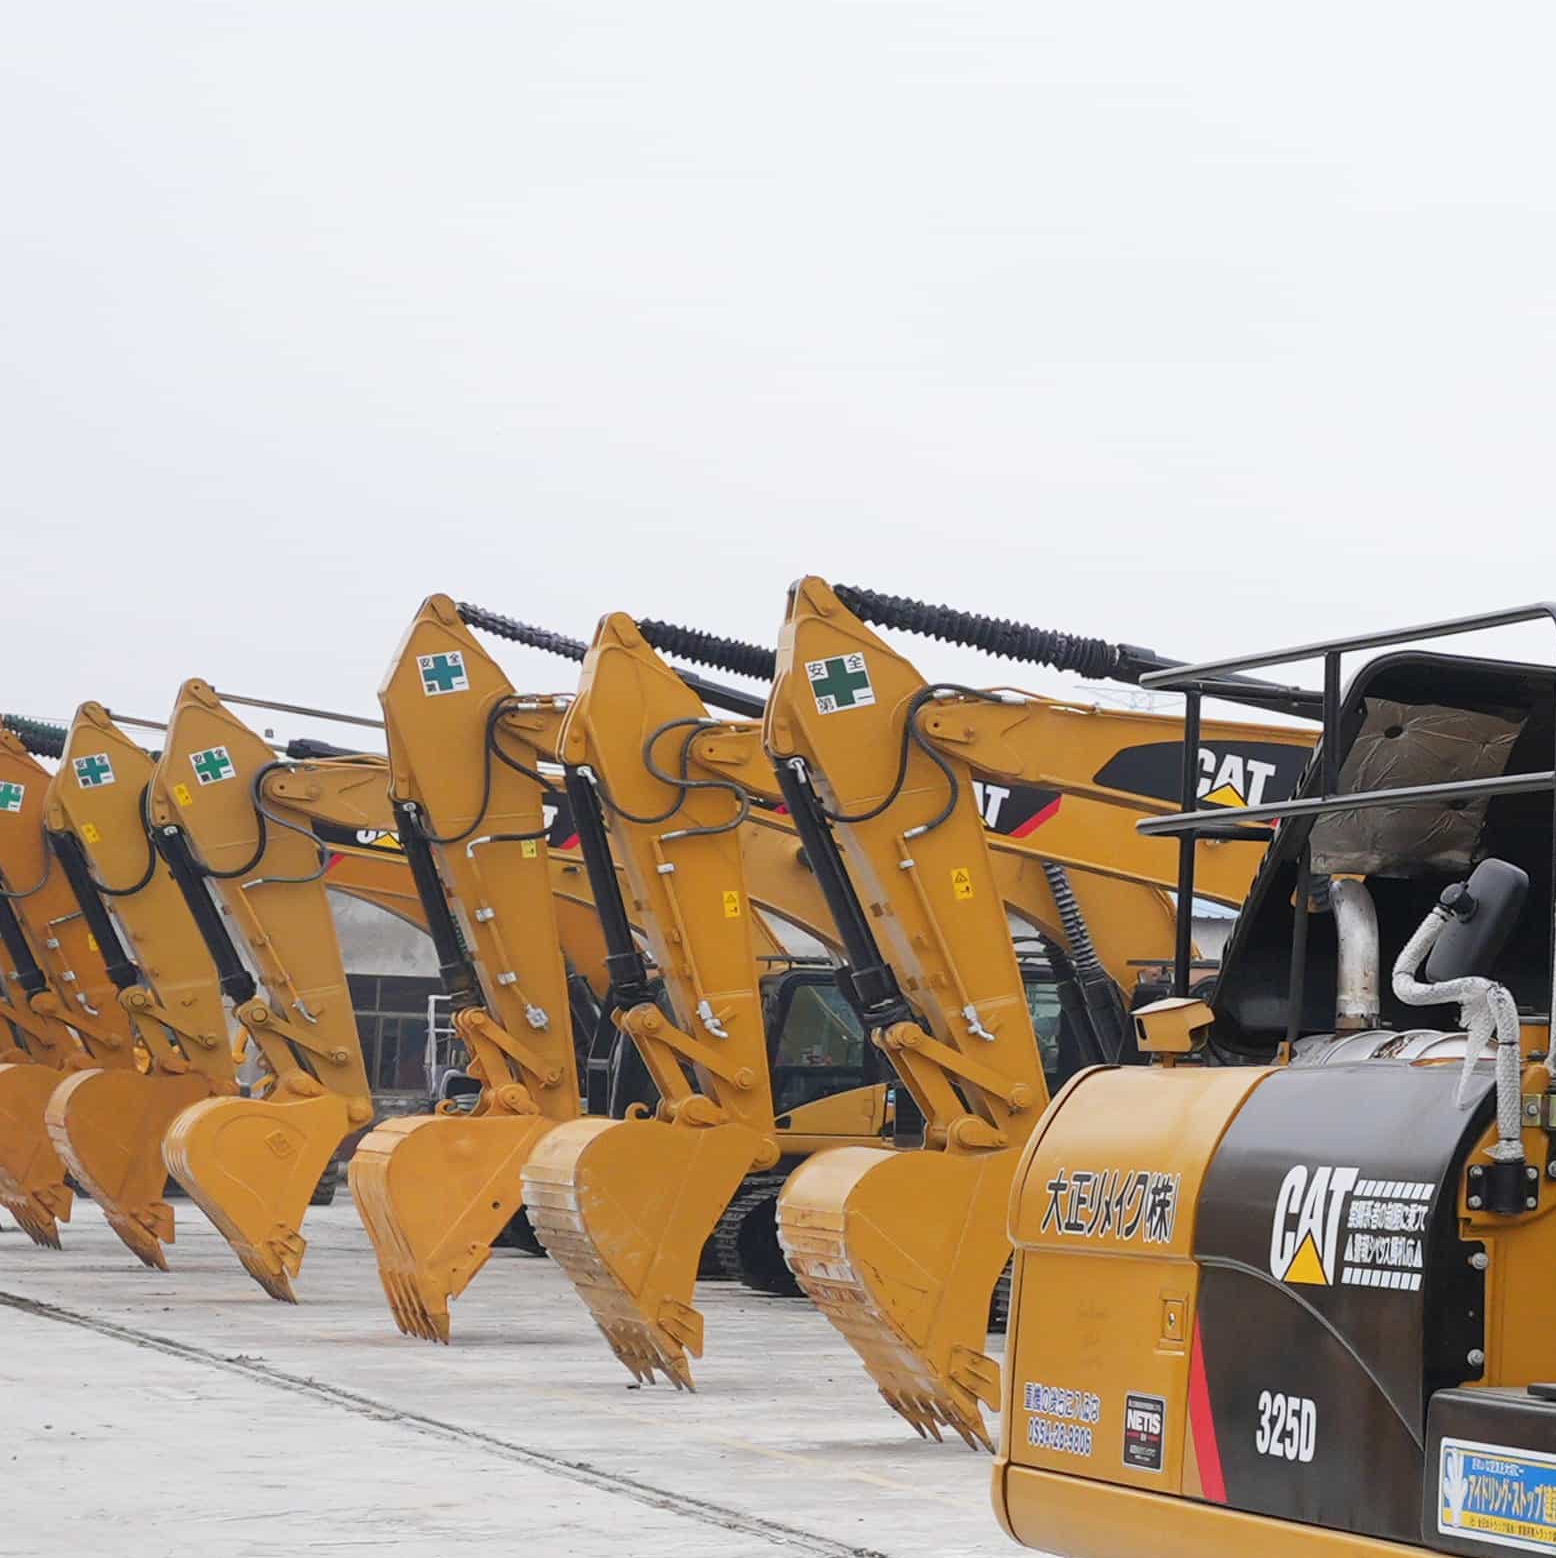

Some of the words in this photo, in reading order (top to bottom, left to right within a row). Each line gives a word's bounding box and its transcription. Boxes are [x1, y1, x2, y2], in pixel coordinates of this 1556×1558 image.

[1040, 1167, 1181, 1243] 大正リメイク(株)
[1270, 1165, 1359, 1286] CAT
[1127, 1409, 1160, 1435] NETIS
[1256, 1389, 1317, 1463] 325D
